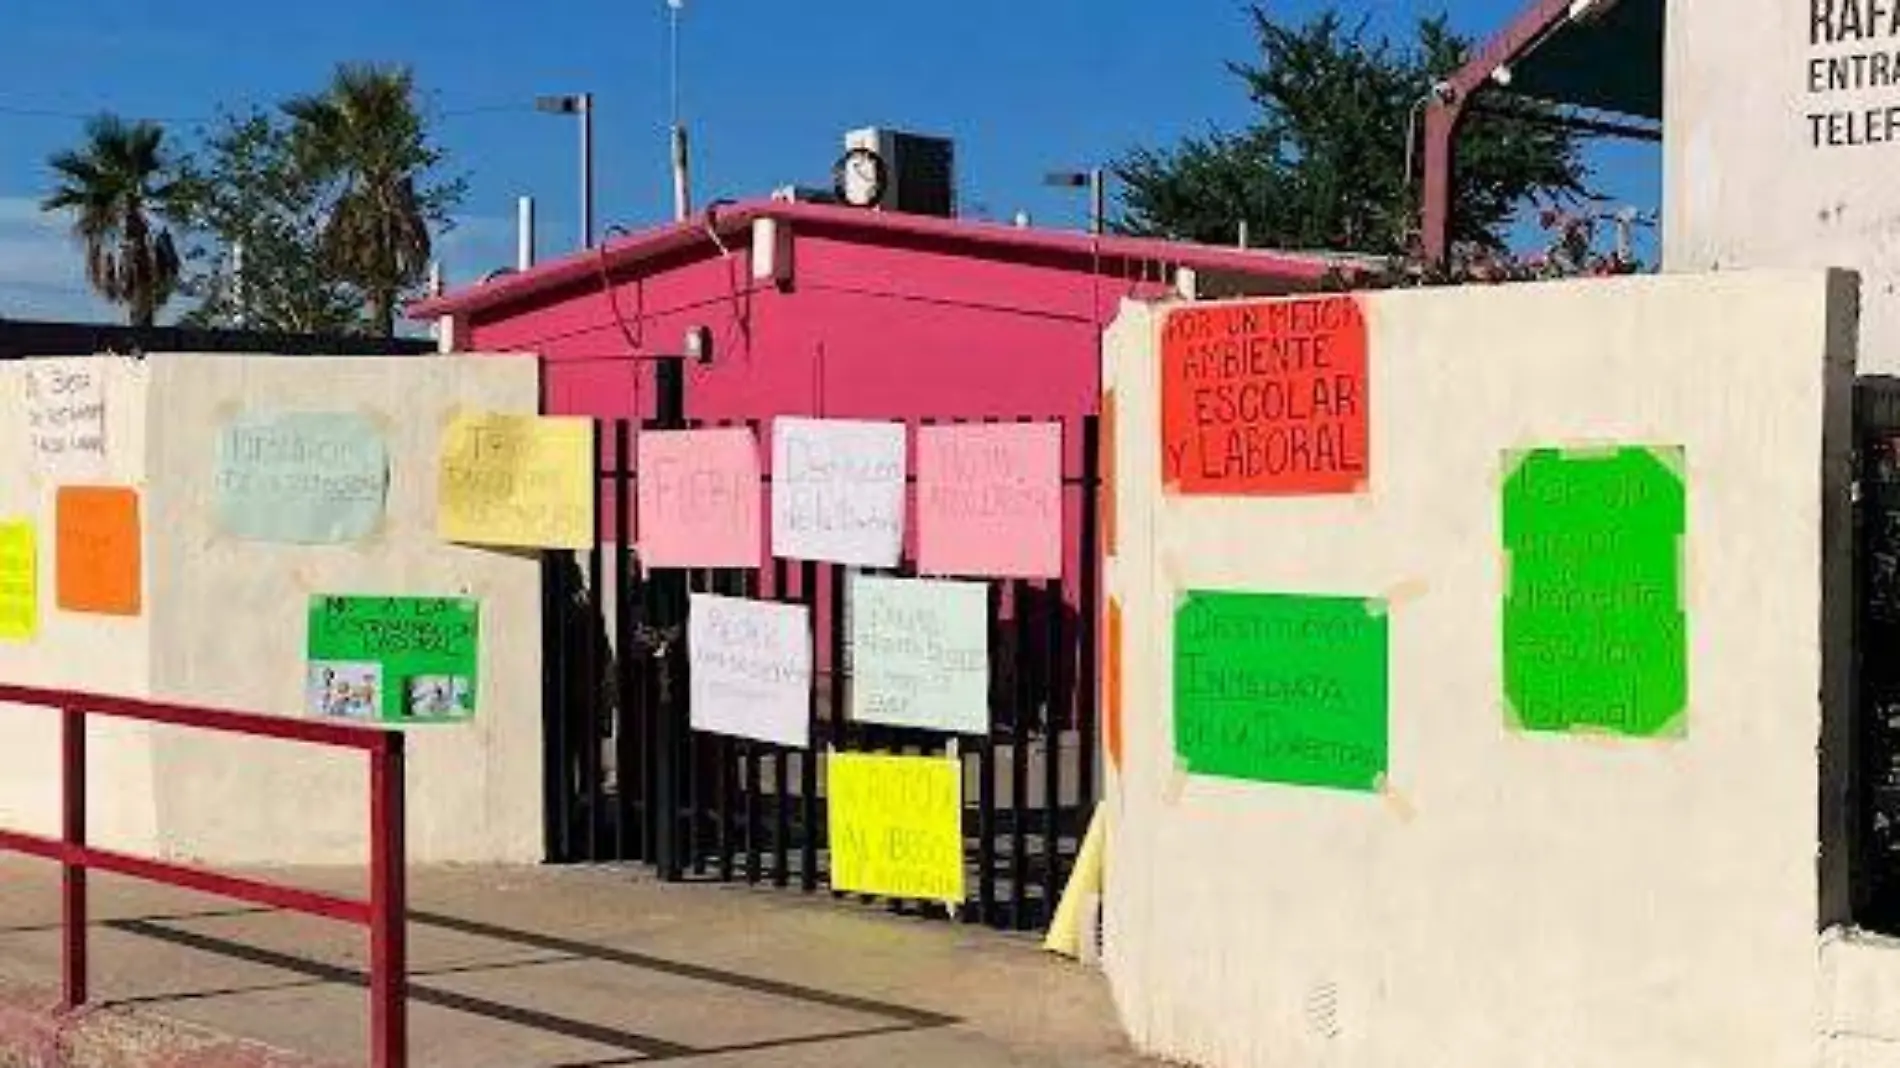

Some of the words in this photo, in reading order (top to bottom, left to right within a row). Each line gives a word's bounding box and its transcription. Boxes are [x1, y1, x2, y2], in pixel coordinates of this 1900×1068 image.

[1184, 334, 1331, 380] AMBIENTE
[1195, 374, 1356, 428] ESCOLAR
[1168, 441, 1188, 479] Y
[1202, 424, 1363, 480] LABORAL
